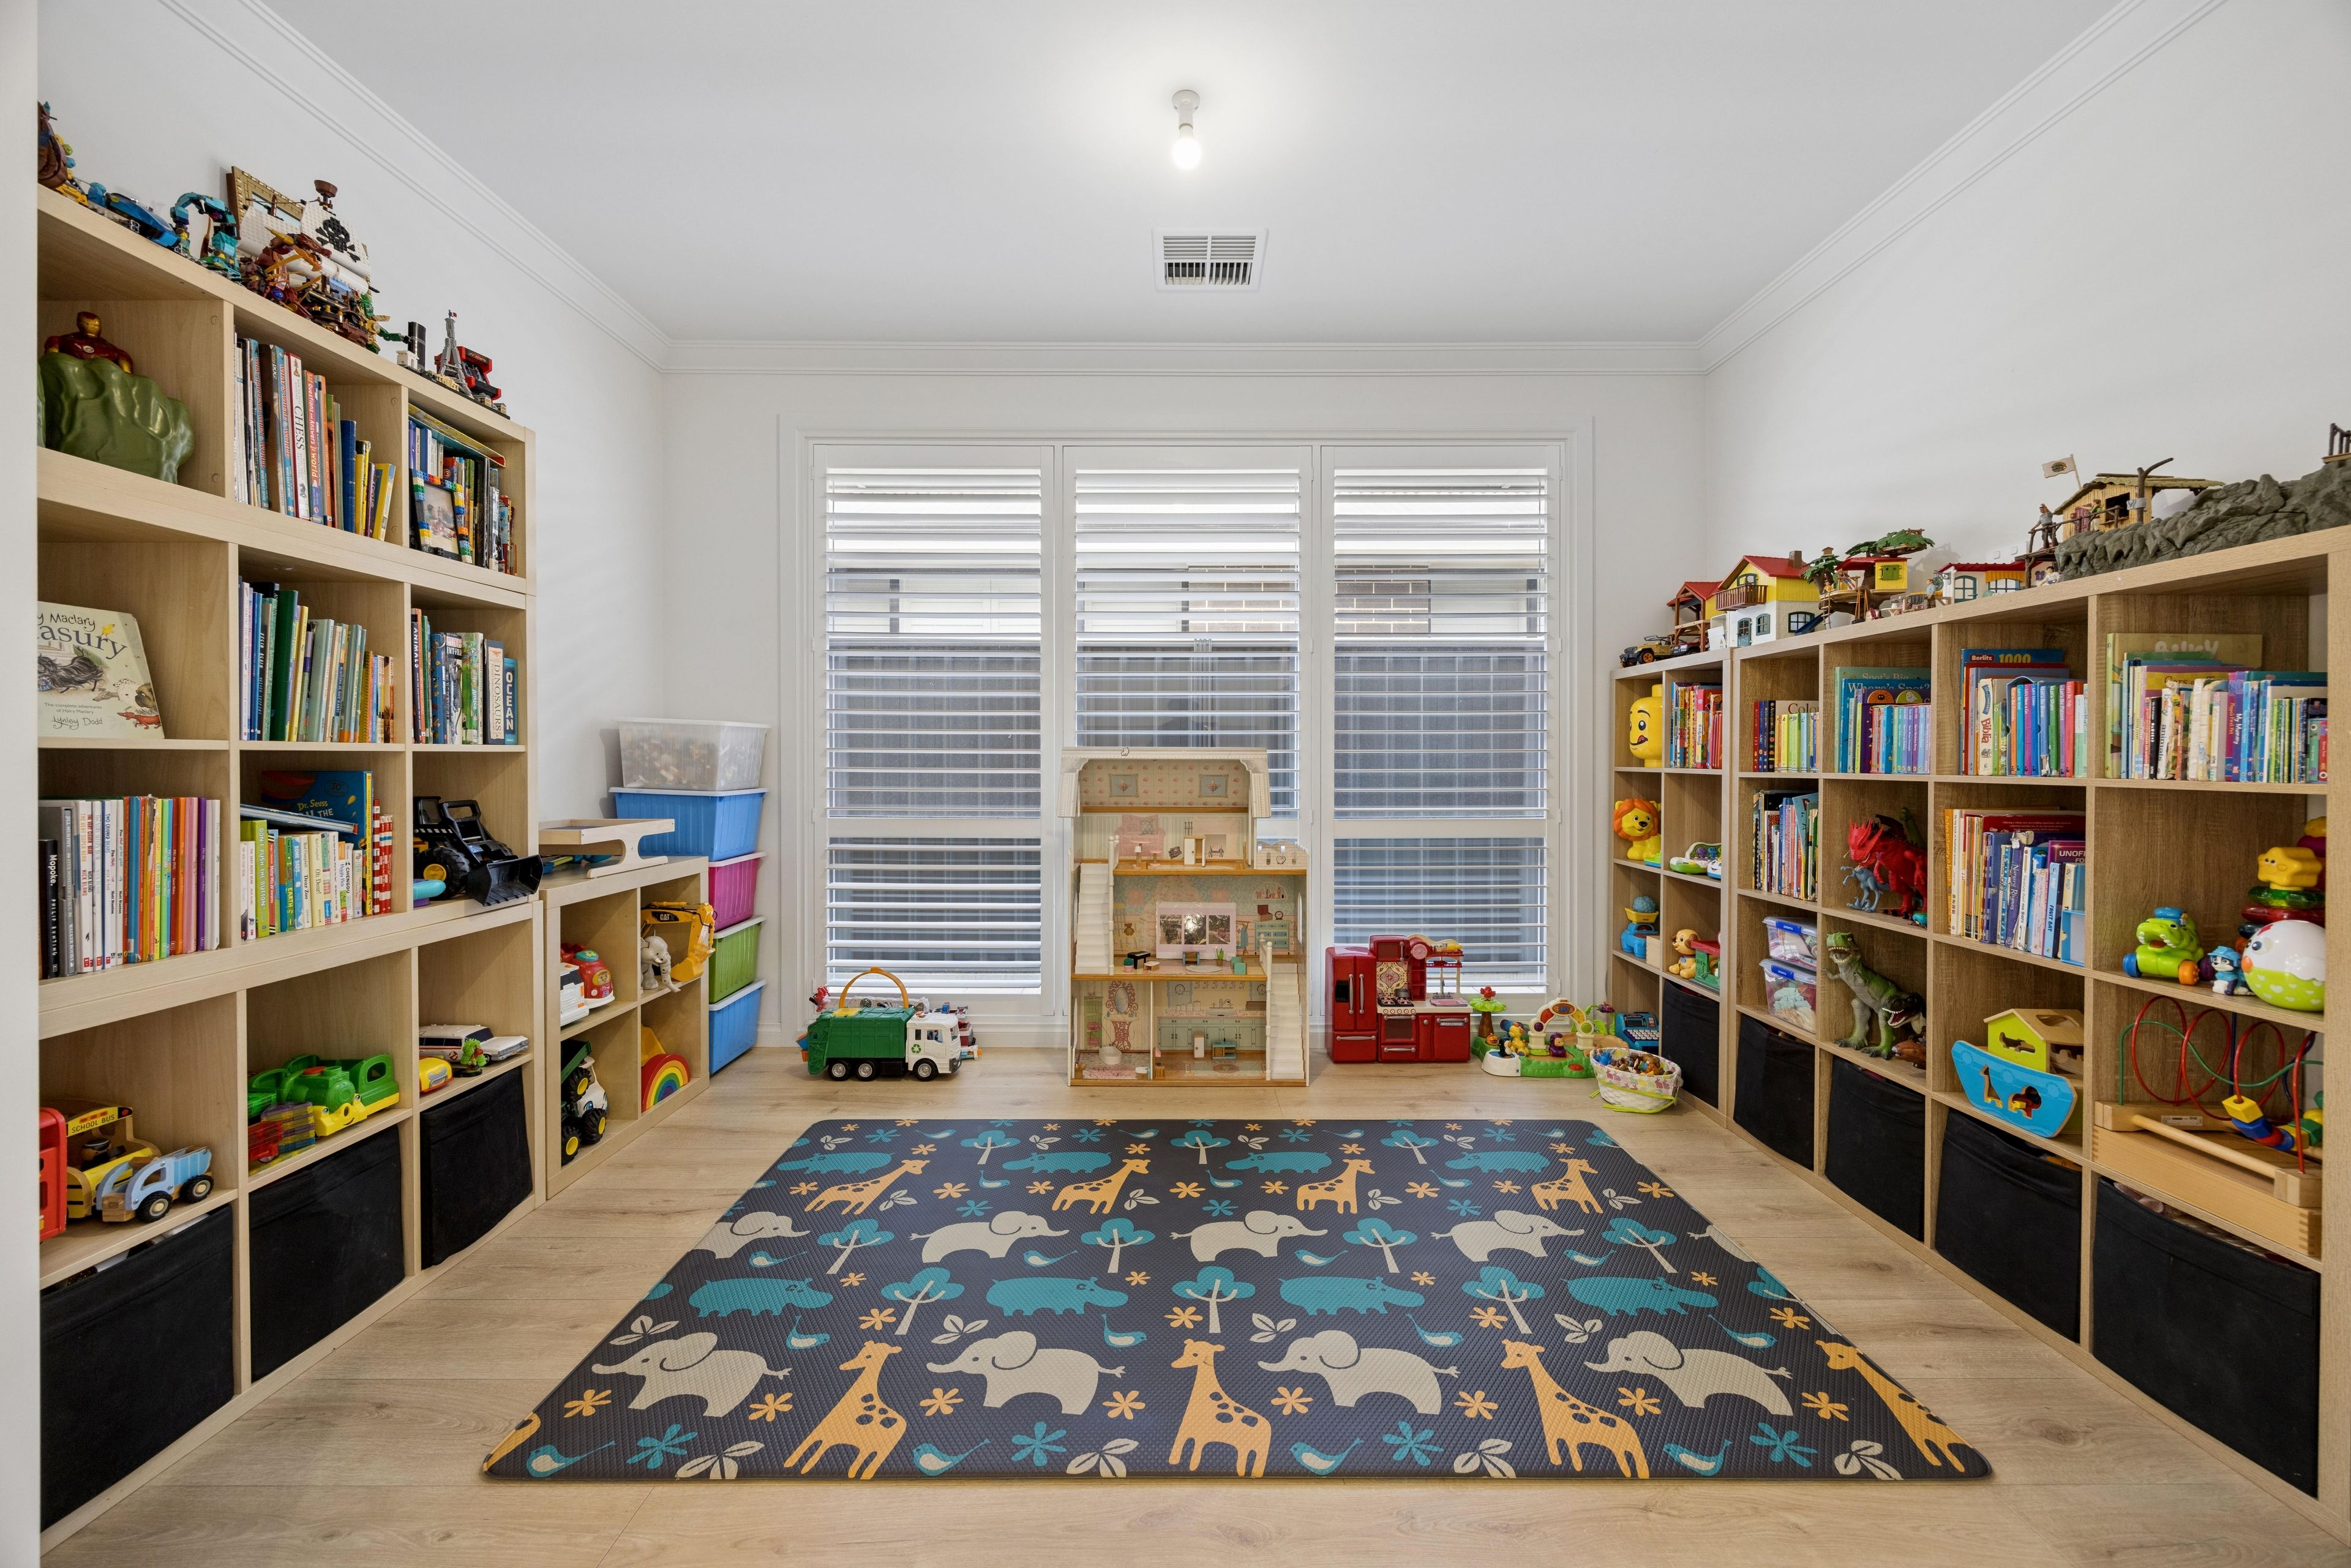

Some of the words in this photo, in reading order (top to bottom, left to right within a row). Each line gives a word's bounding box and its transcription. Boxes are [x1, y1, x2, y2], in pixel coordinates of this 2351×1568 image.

[294, 406, 305, 451] CHESS
[50, 613, 95, 632] Maclary
[38, 626, 127, 659] asury
[1999, 654, 2031, 662] 1000
[1788, 703, 1818, 715] Colo
[2161, 694, 2170, 716] baby
[50, 716, 79, 730] Lynley
[2235, 713, 2242, 722] My
[1981, 718, 1991, 743] Biblia
[2233, 724, 2242, 745] Mummy
[2158, 724, 2167, 761] animals
[298, 803, 309, 811] Dr.
[310, 799, 328, 808] Seuss
[318, 808, 333, 817] THE
[315, 869, 321, 878] Oh
[2011, 865, 2019, 887] Nursery
[71, 1119, 99, 1133] SCHOOL
[101, 1114, 115, 1126] BUS
